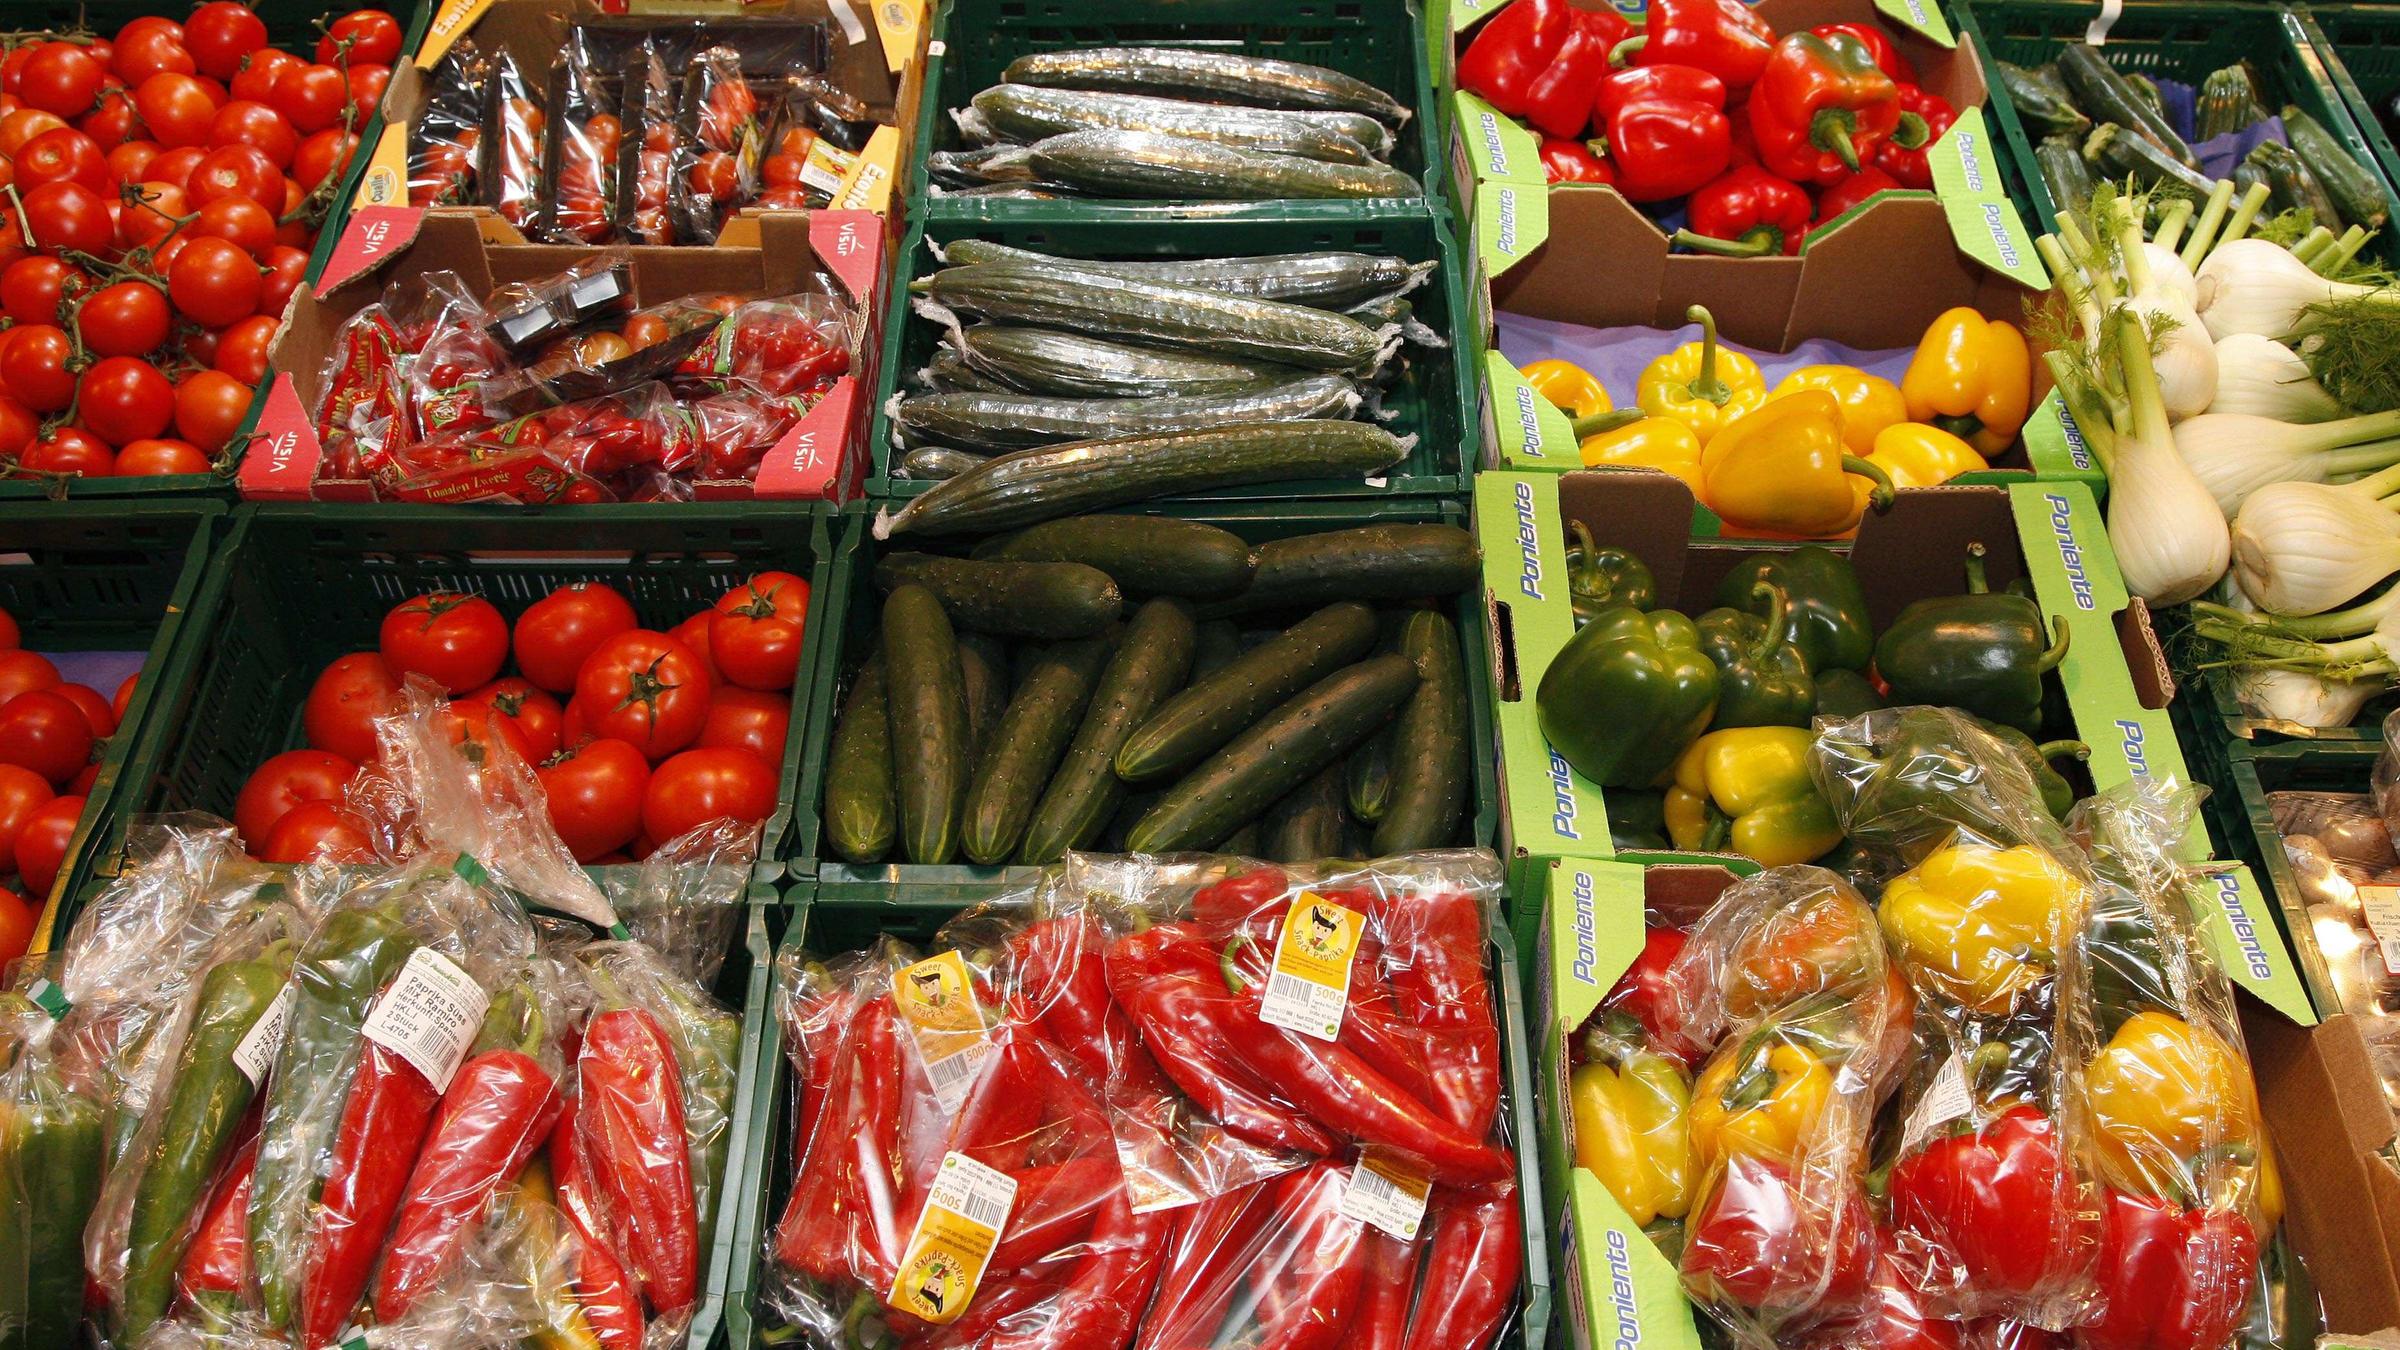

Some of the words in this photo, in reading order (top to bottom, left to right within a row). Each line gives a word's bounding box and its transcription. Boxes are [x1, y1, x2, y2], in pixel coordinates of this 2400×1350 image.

[1480, 112, 1509, 175] Poniente
[1955, 132, 1983, 192] Poniente
[1497, 189, 1516, 255] Poniente
[1980, 203, 2019, 268] Poniente
[1516, 386, 1544, 458] Poniente
[1515, 481, 1545, 601] Poniente
[2044, 492, 2095, 610] Poniente
[1319, 905, 1345, 925] Sweet
[1572, 871, 1597, 986] Poniente
[2211, 874, 2271, 980] Poniente
[913, 963, 942, 976] Sweet
[1294, 929, 1345, 962] Snack-Paprika
[386, 1010, 394, 1019] 2
[403, 984, 421, 999] Mix
[425, 997, 457, 1029] Ramiro
[409, 976, 446, 1006] Paprika
[932, 1188, 962, 1210] 500g
[914, 1250, 965, 1288] Snack-Paprika
[911, 1294, 936, 1315] Sweet
